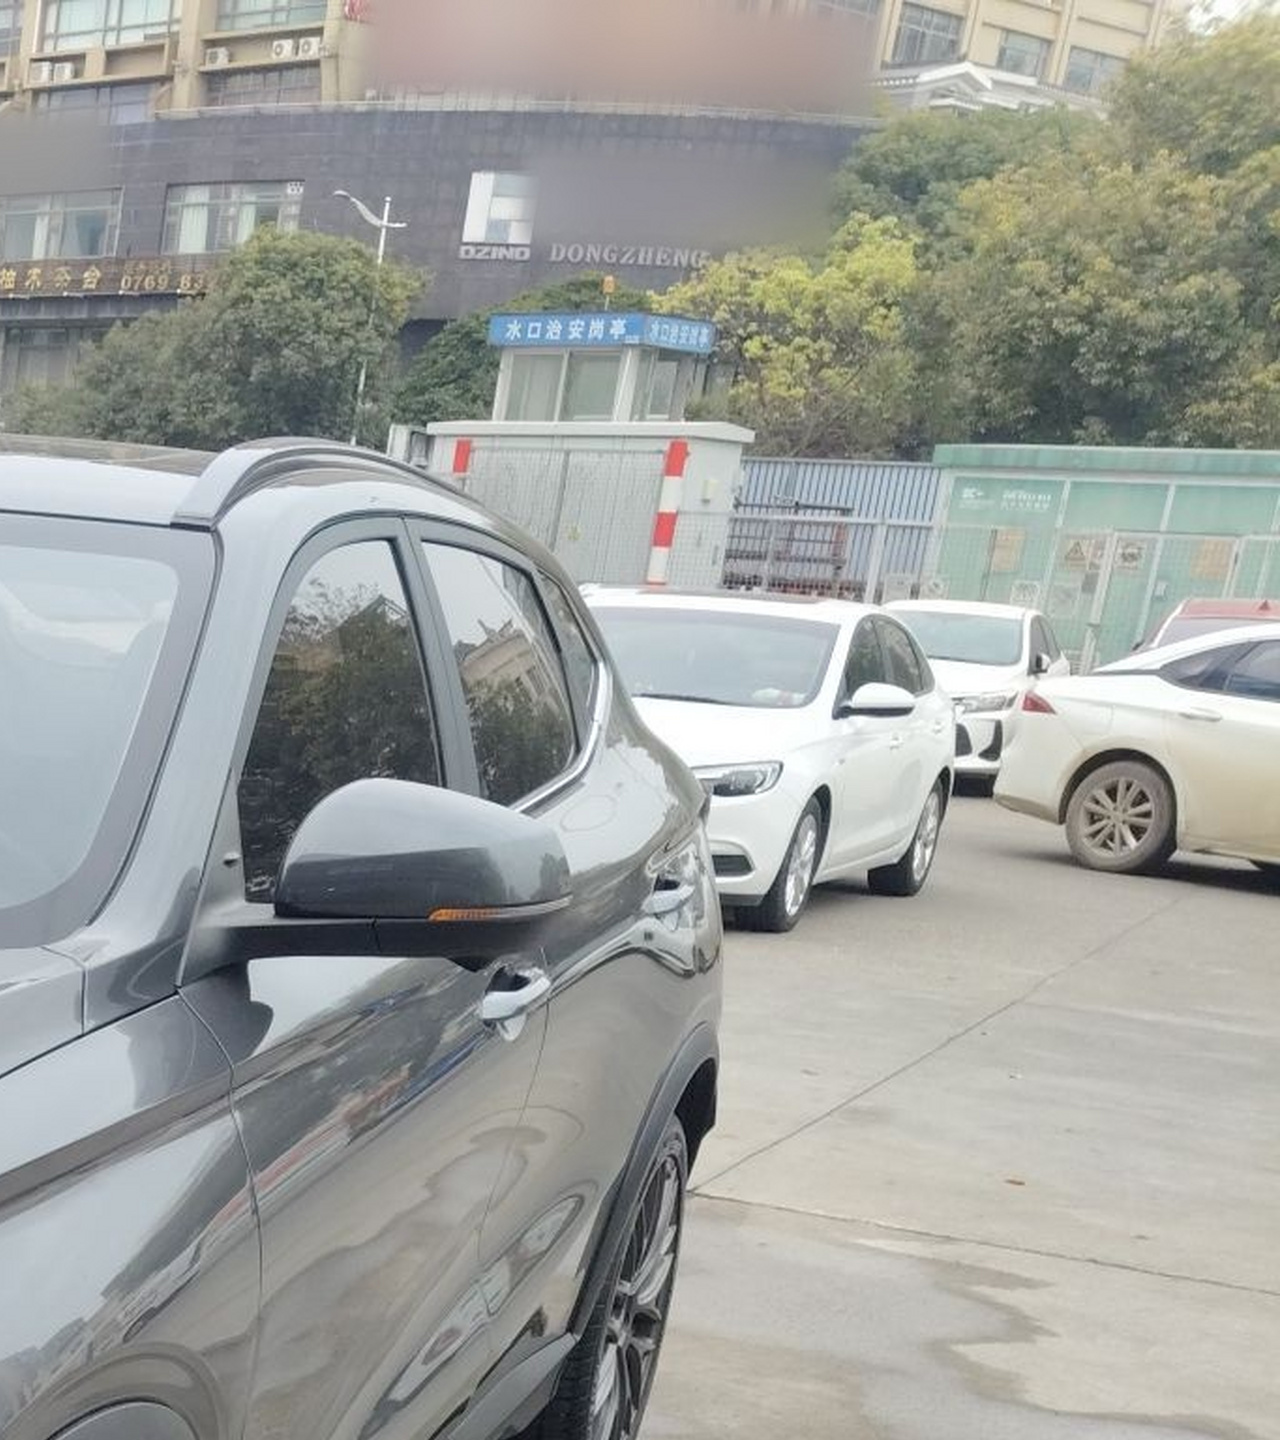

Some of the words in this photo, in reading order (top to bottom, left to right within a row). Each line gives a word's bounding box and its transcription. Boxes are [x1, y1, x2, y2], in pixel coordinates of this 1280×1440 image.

[119, 274, 170, 291] 0769
[505, 317, 627, 341] 水口治安岗亭
